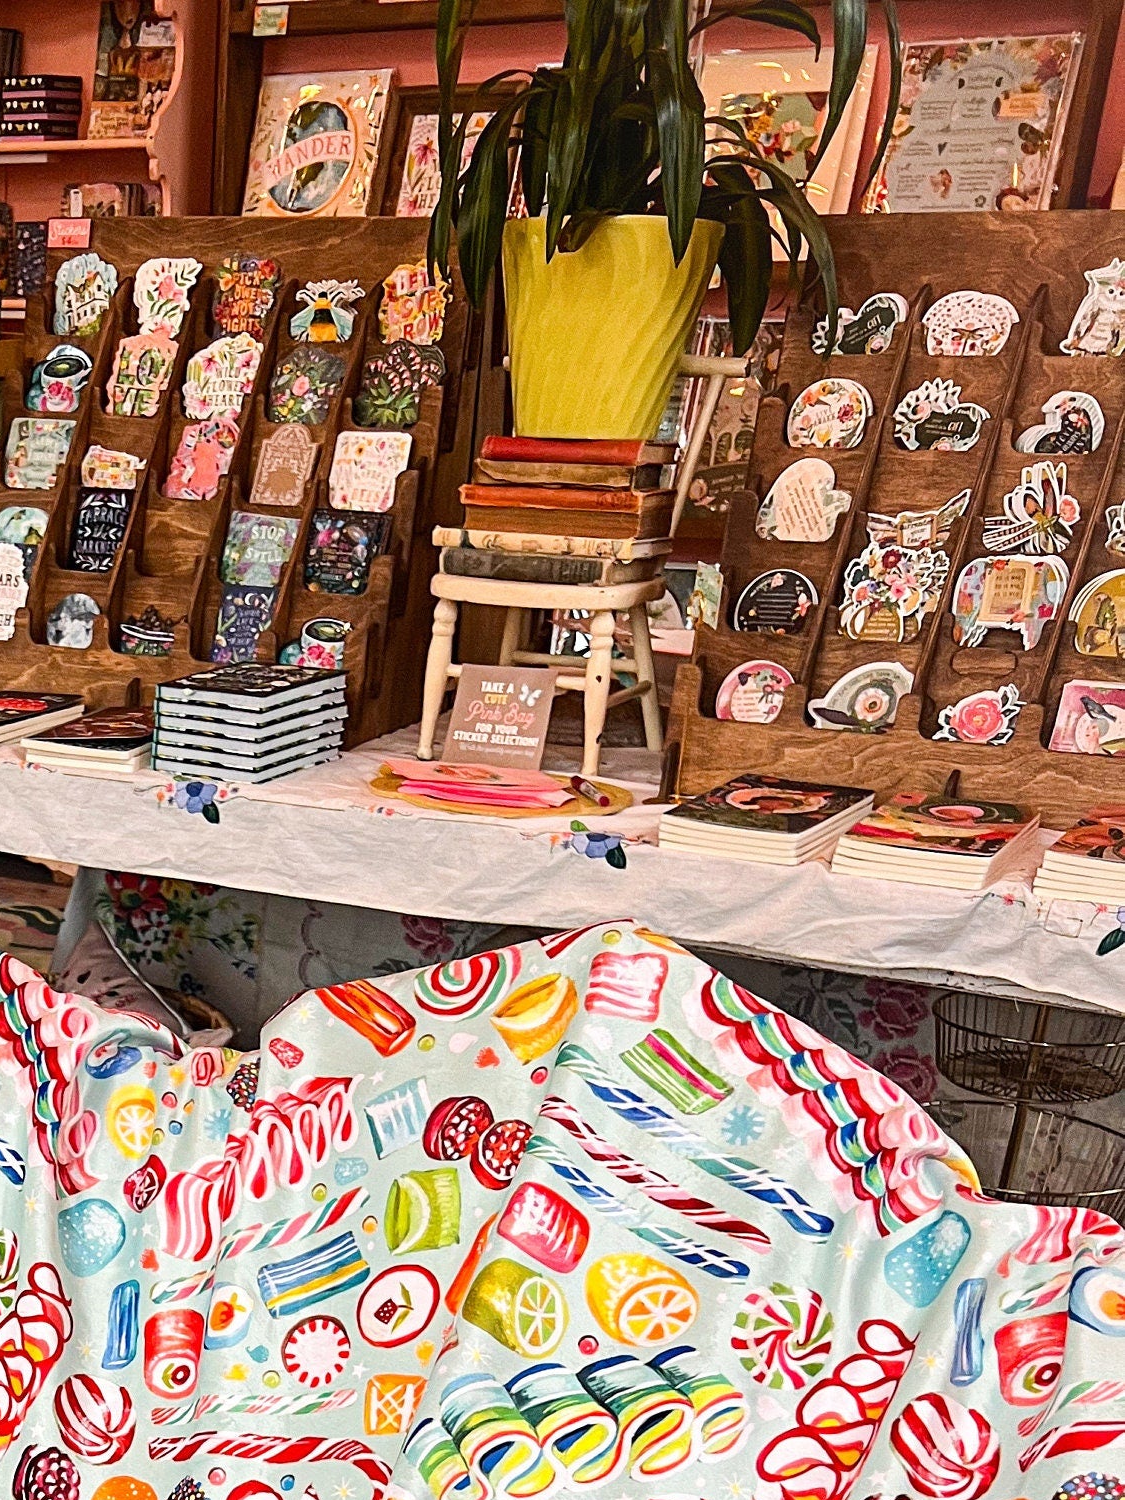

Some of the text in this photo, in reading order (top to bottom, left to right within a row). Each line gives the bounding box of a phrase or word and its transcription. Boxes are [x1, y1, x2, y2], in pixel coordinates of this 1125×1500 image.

[266, 134, 352, 178] WANDER
[206, 379, 243, 394] FLOWE
[251, 524, 286, 542] STOP
[481, 681, 515, 694] TAKE A
[484, 693, 509, 705] CUTE
[464, 699, 536, 730] Pink Bag
[475, 722, 519, 736] FOR YOUR
[453, 730, 489, 743] STICKER
